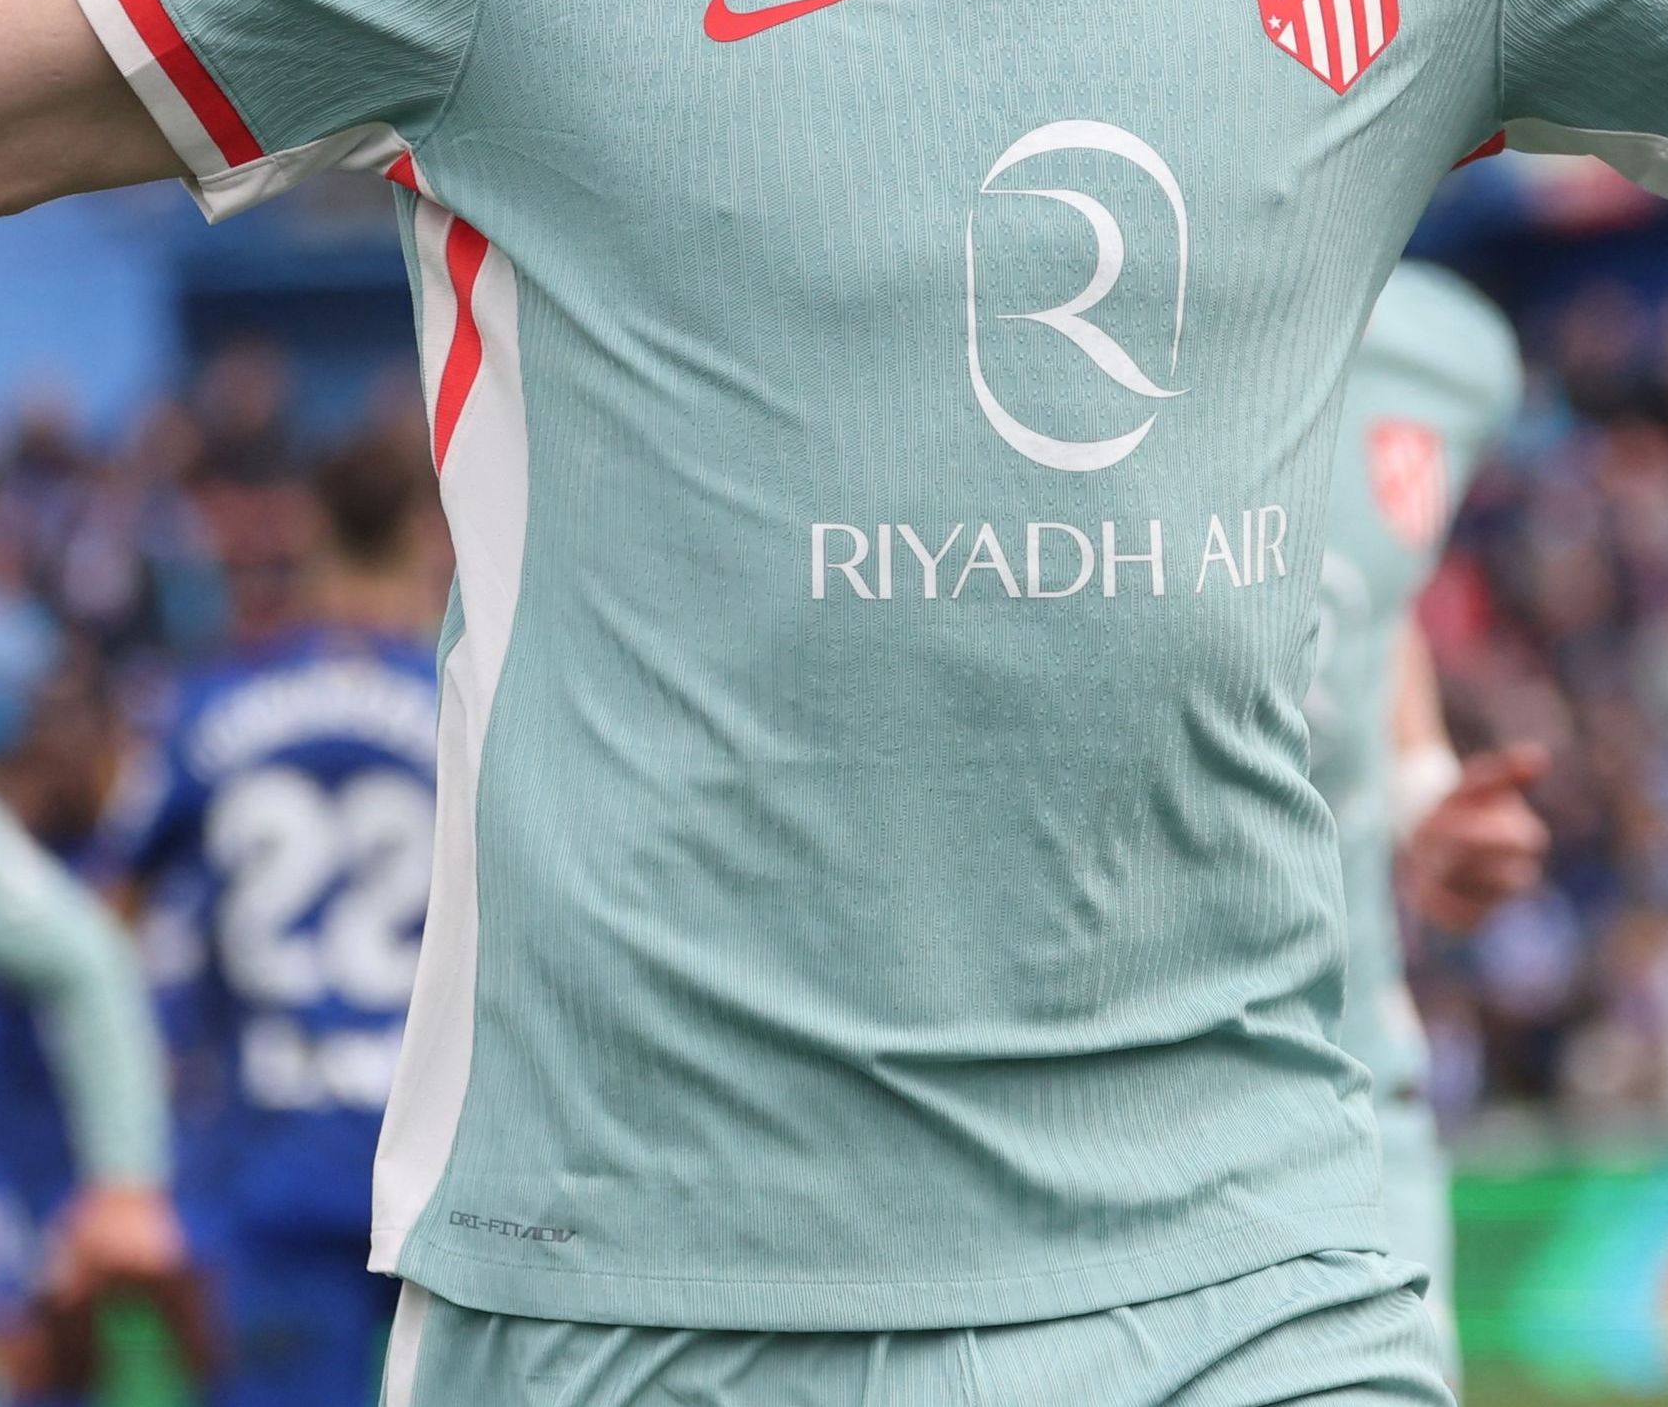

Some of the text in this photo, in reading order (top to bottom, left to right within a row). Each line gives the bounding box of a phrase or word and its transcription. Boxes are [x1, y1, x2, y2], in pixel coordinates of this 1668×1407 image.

[811, 503, 1287, 601] RIYADH AIR
[207, 764, 432, 1010] 22
